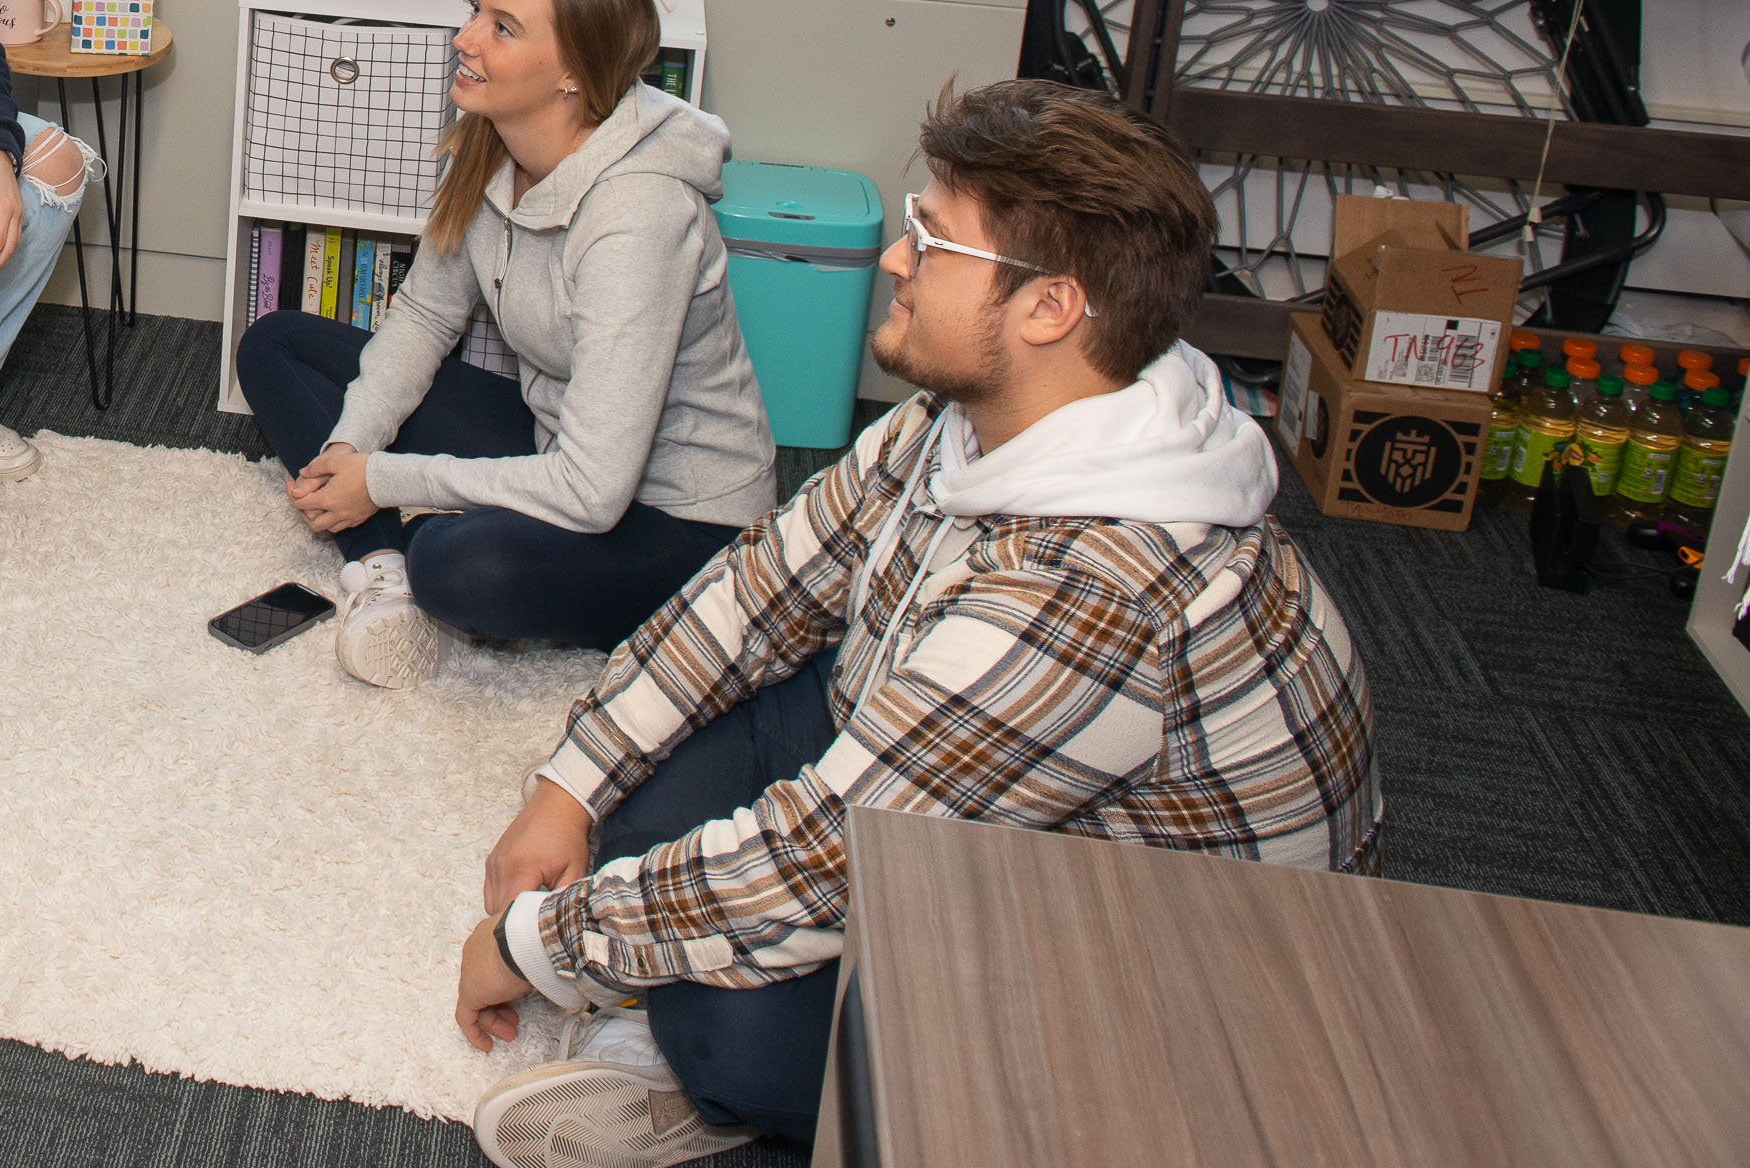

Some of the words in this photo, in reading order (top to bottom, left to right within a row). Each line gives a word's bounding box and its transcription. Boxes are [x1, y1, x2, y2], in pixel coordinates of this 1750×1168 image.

[309, 240, 322, 270] Meet
[325, 255, 335, 275] Speak
[308, 276, 318, 299] Cute
[325, 276, 333, 288] Up!
